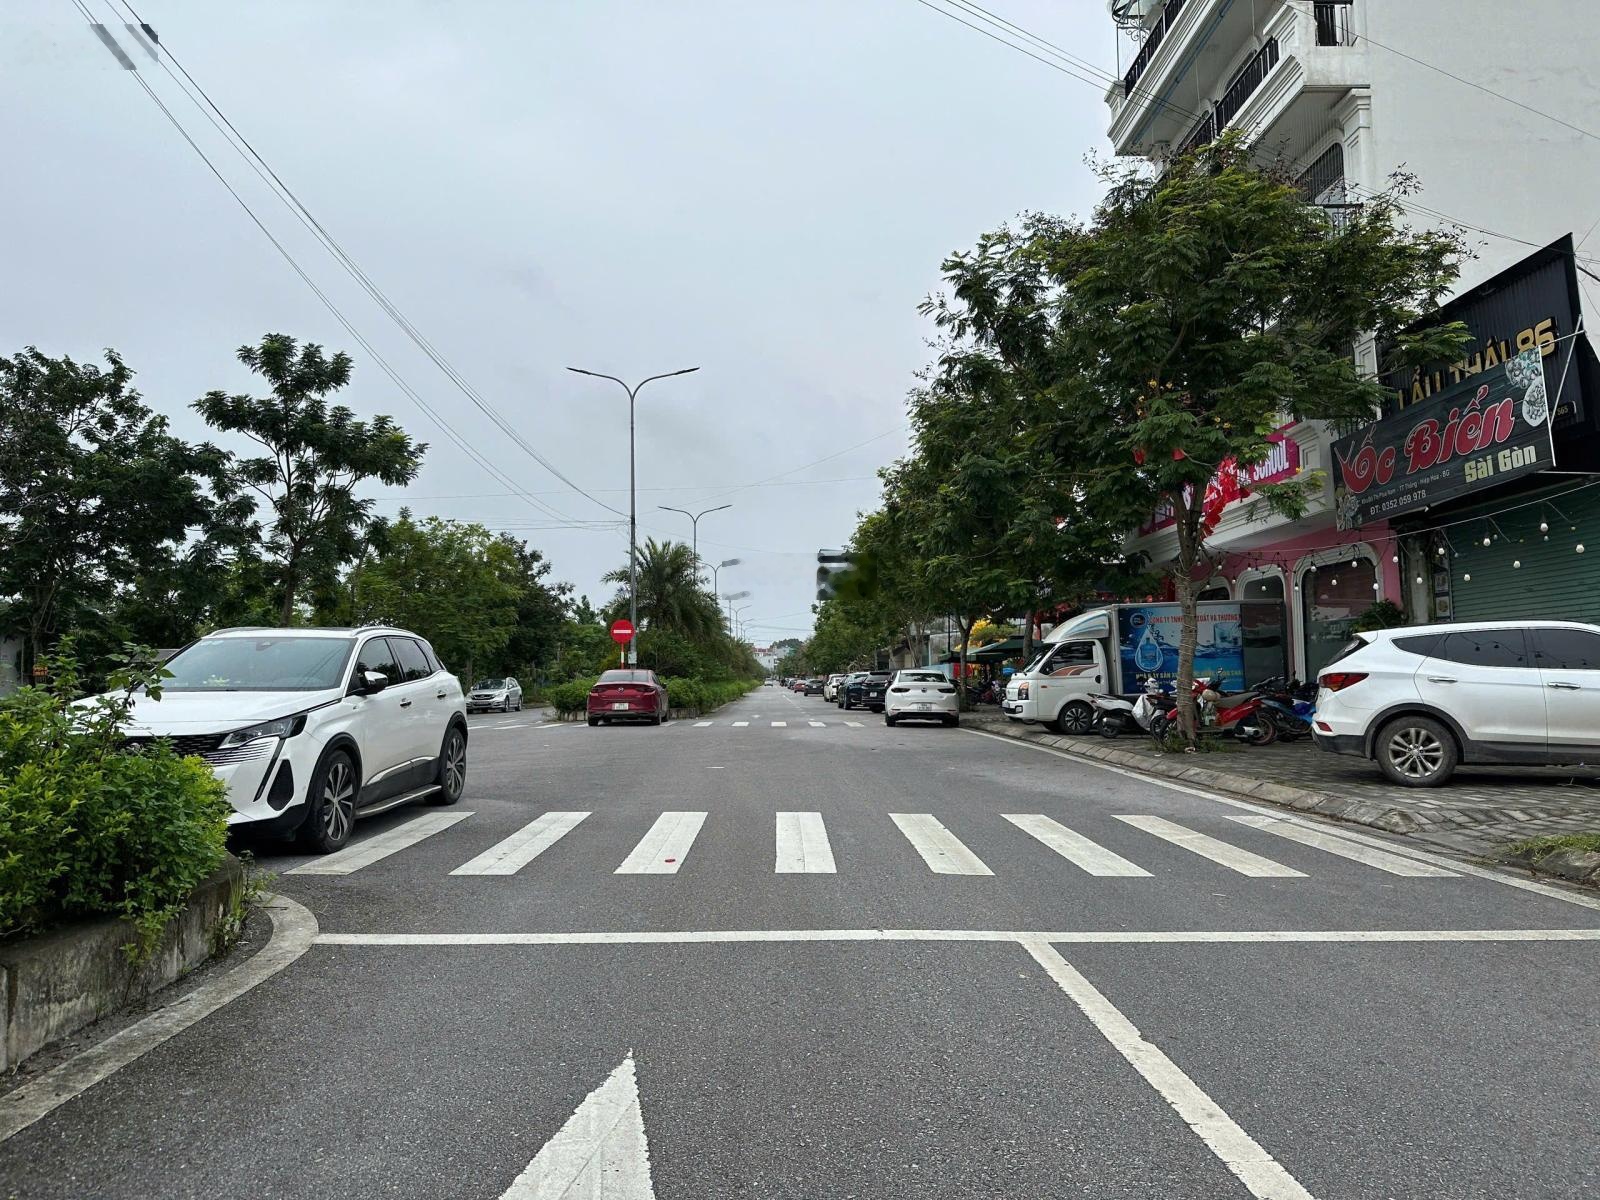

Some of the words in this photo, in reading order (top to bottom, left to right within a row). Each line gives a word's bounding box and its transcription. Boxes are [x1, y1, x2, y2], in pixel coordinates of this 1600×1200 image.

[1449, 338, 1509, 384] THÁI
[1516, 317, 1557, 358] 86
[1335, 425, 1396, 494] Ốc
[1404, 384, 1515, 475] Biển
[1464, 453, 1494, 484] Sài
[1498, 444, 1537, 473] Gòn
